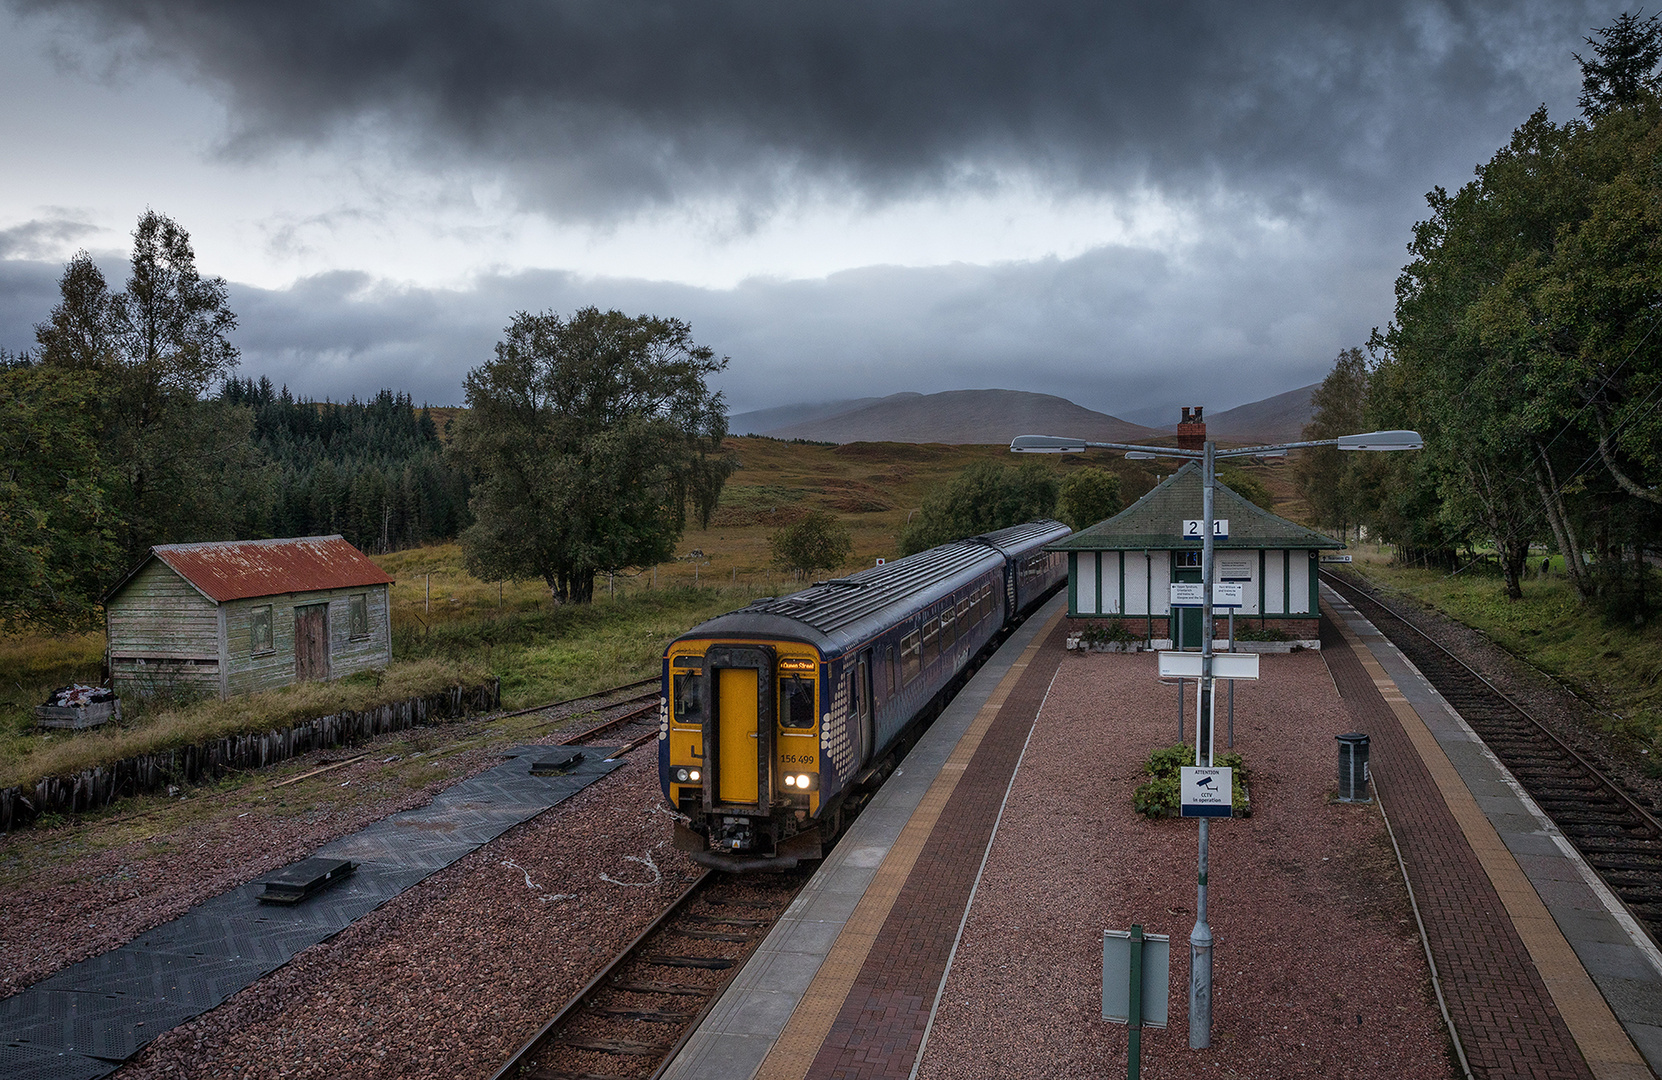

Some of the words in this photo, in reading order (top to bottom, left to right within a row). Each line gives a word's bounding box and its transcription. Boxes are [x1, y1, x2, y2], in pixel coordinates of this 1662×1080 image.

[1189, 521, 1198, 535] 2
[1213, 521, 1222, 535] 1
[781, 754, 796, 764] 156
[798, 755, 814, 764] 499
